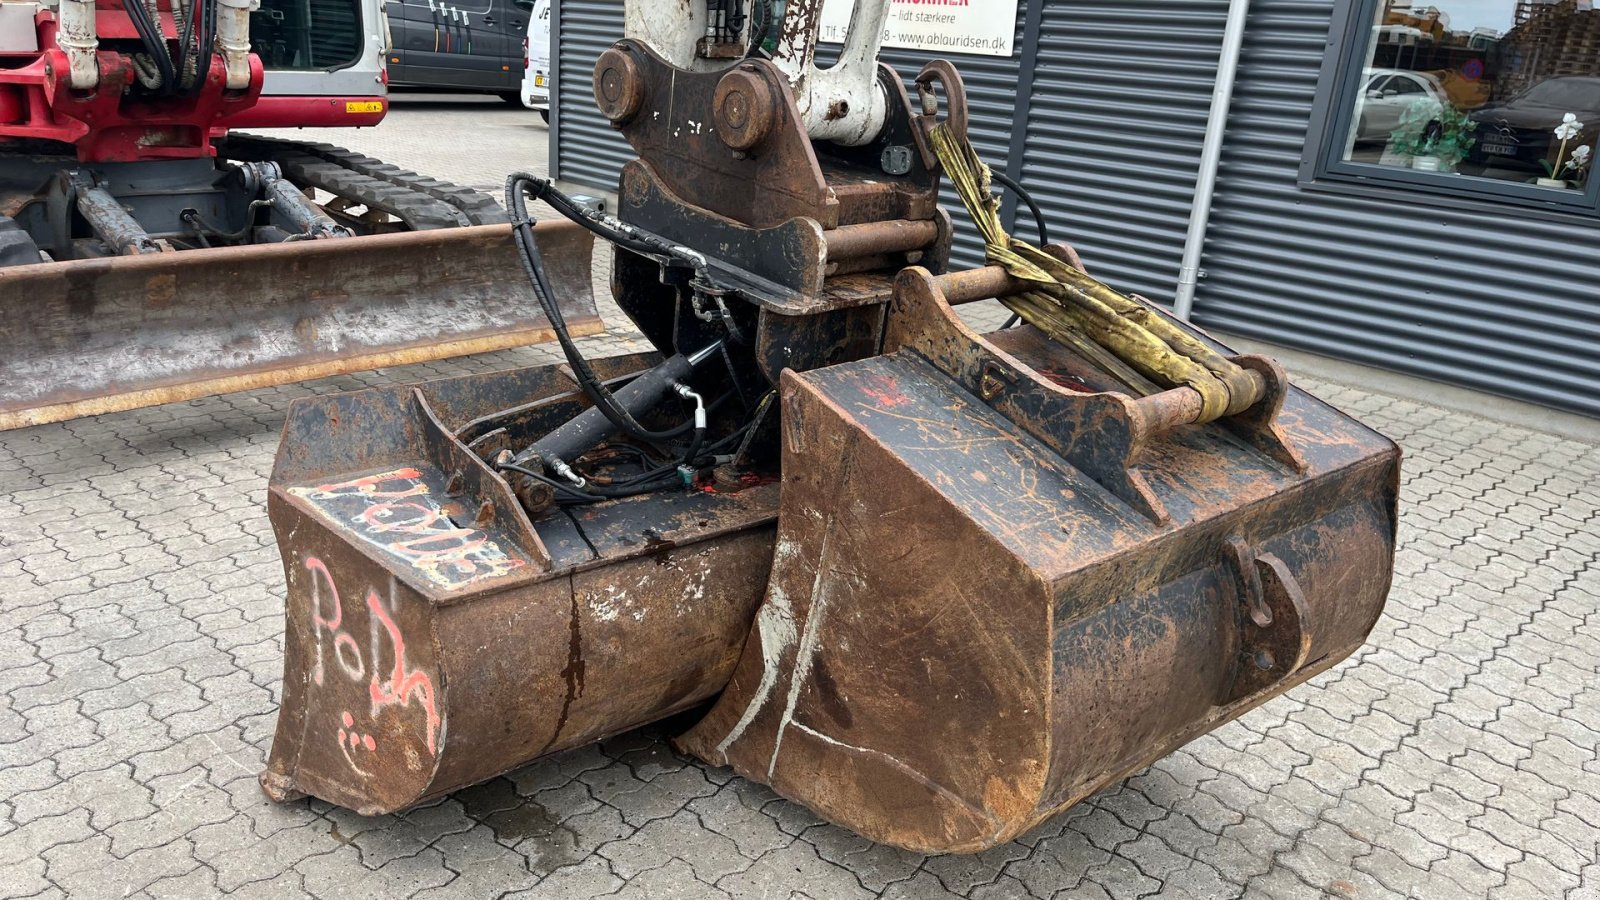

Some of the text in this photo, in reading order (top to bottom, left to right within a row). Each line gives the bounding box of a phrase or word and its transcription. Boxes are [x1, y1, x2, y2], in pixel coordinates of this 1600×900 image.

[898, 10, 913, 21] lidt
[915, 11, 956, 23] stærkere
[825, 25, 839, 40] Tlf.
[898, 32, 1006, 50] www.ablauridsen.dk
